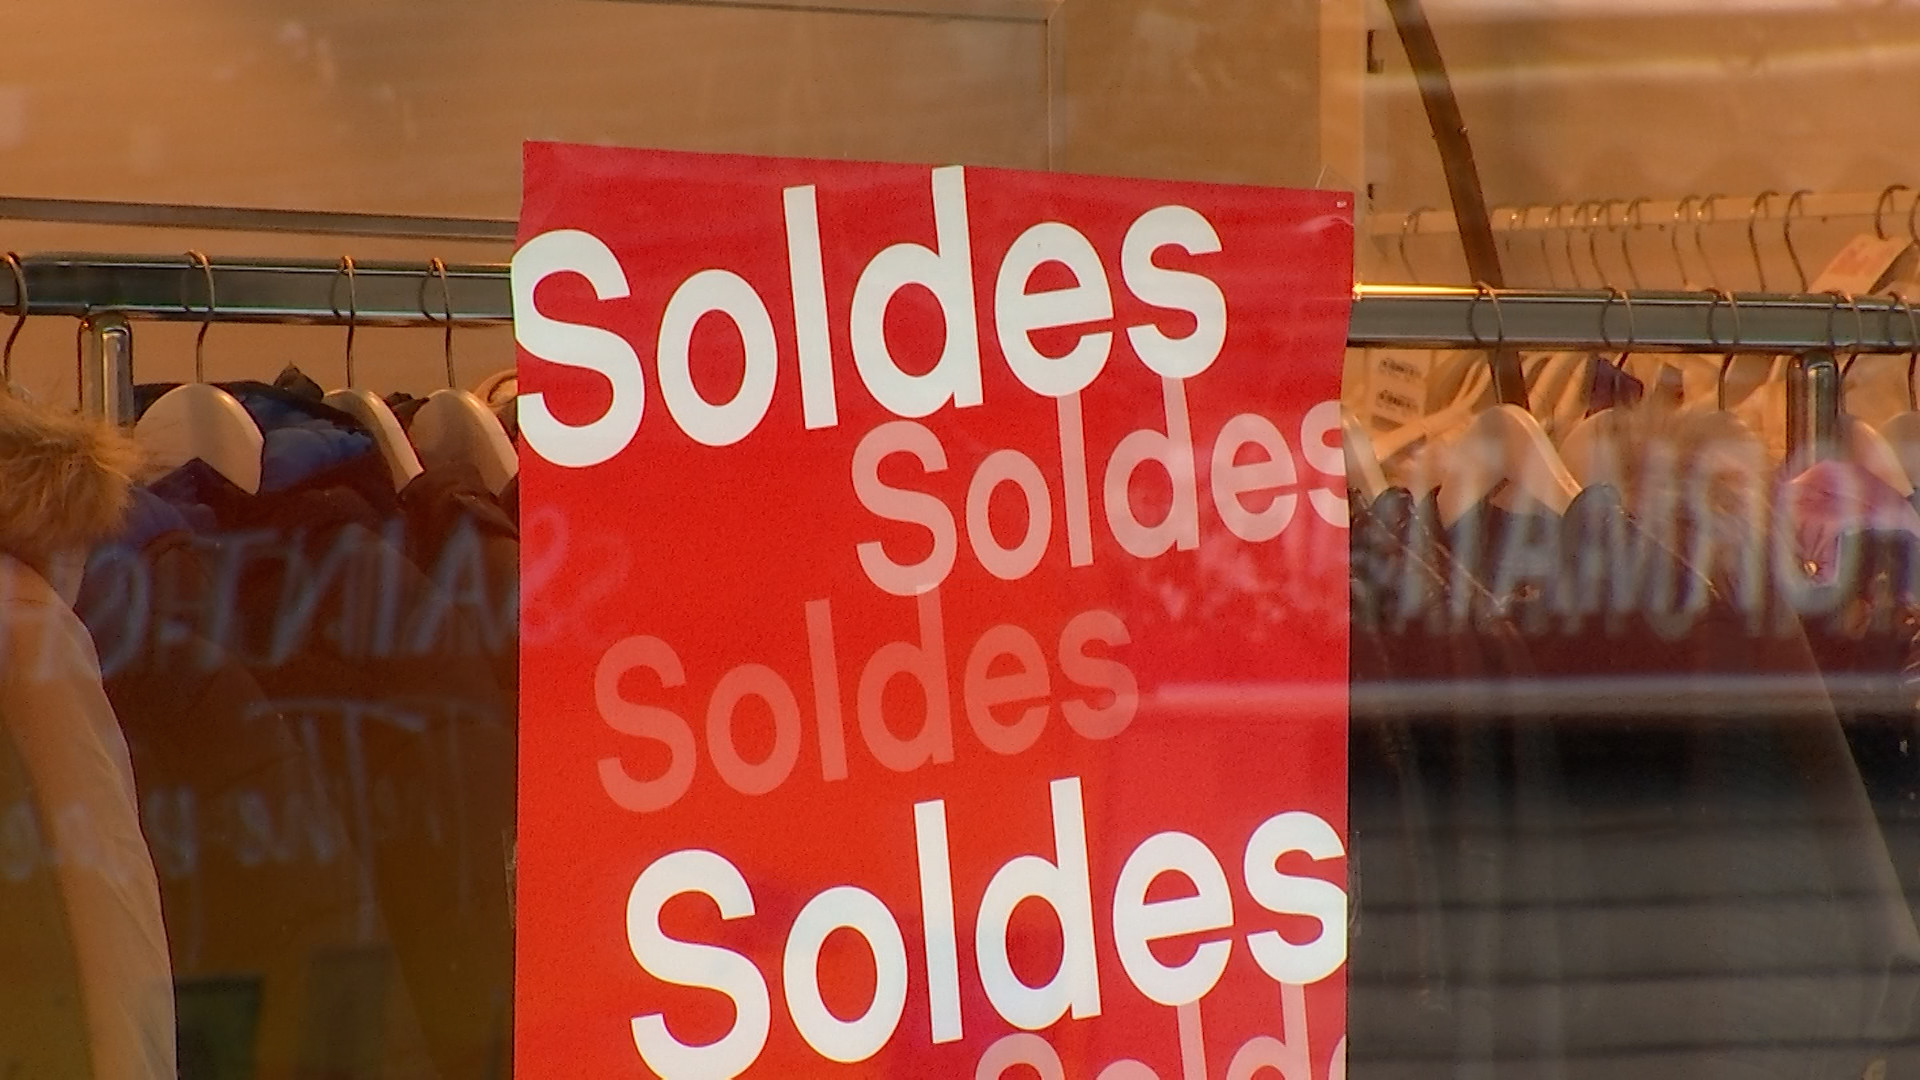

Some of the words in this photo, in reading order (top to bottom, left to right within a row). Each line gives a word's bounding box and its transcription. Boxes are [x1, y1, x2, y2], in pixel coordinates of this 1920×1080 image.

[511, 166, 1227, 468] Soldes
[851, 377, 1349, 597] Soldes
[595, 584, 1140, 813] Soldes
[626, 776, 1348, 1080] Soldes
